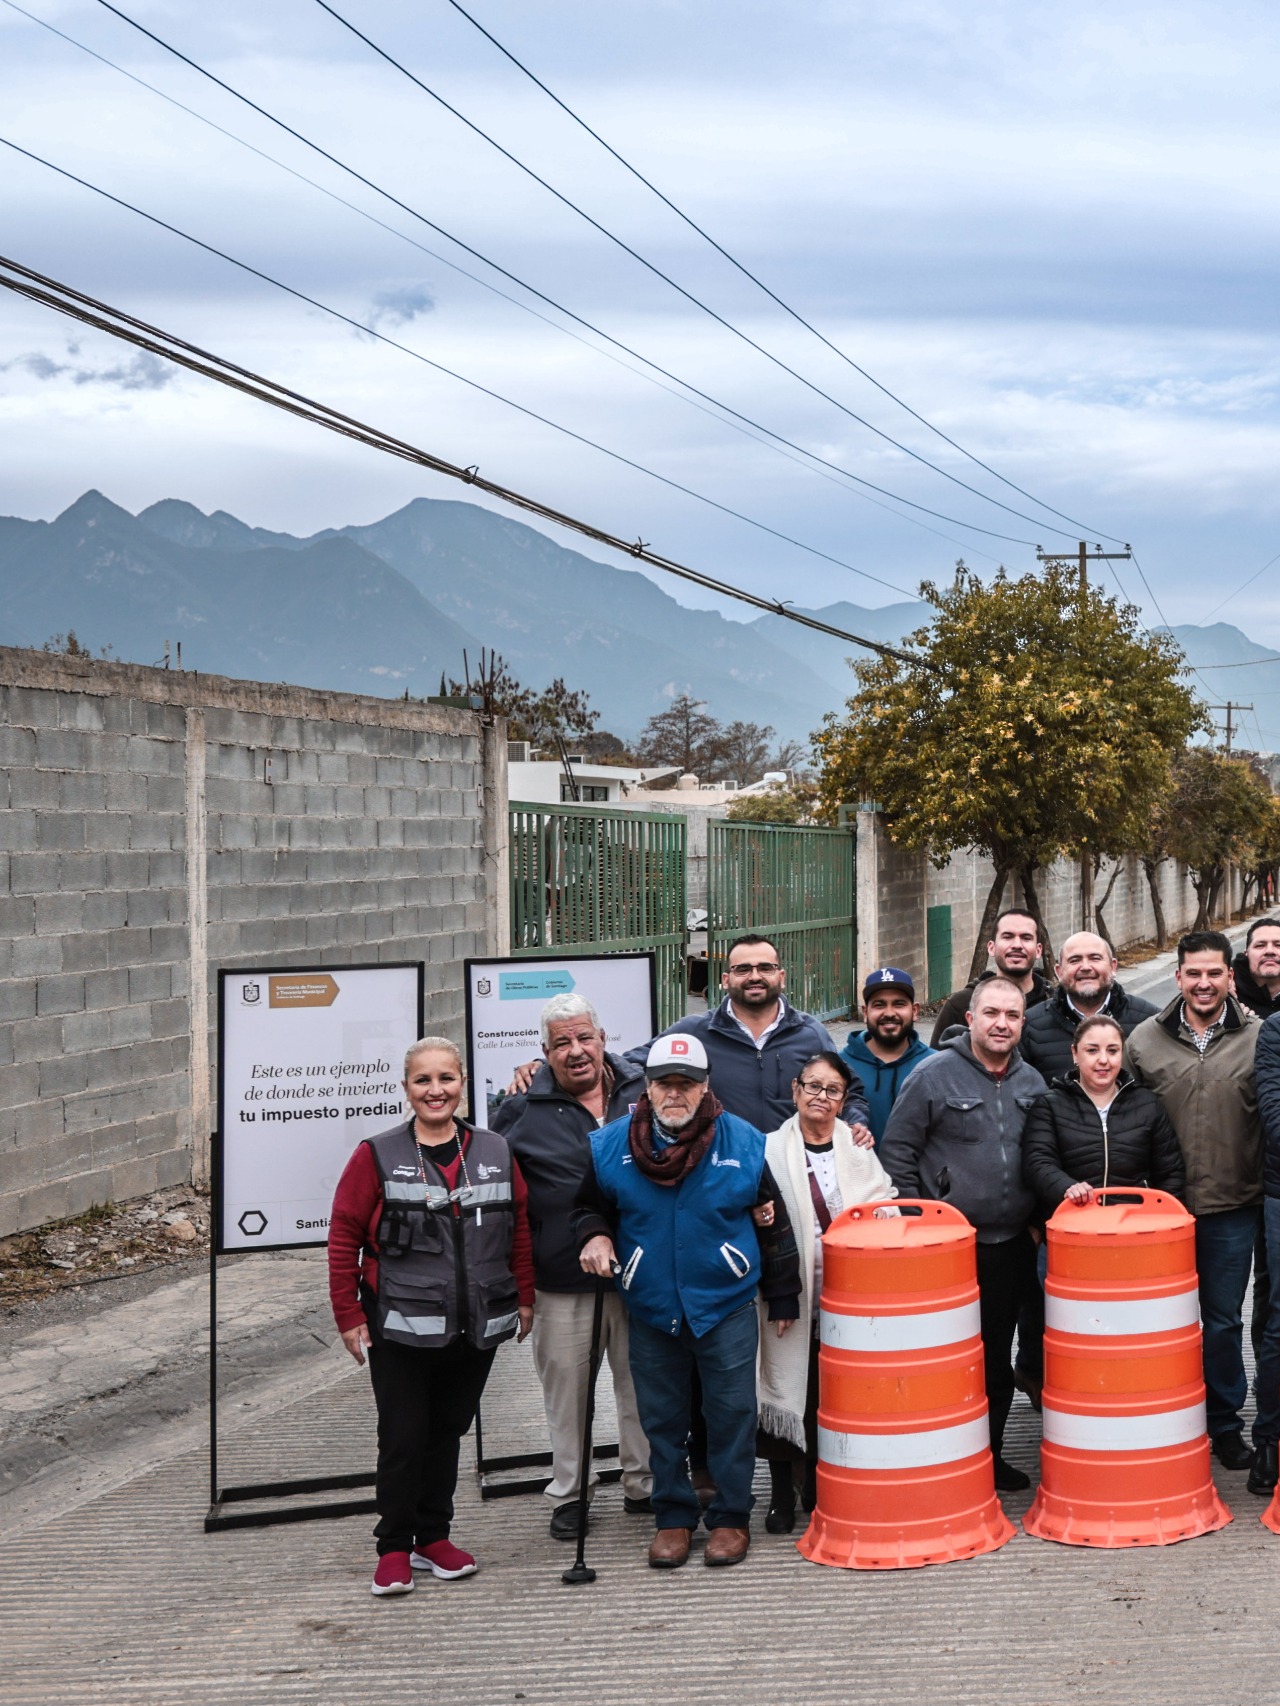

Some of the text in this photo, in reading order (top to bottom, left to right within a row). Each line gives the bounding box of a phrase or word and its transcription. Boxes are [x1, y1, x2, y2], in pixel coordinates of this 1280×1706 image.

[477, 1028, 539, 1039] Construcción
[477, 1040, 498, 1050] Calle
[500, 1040, 514, 1048] Los
[516, 1039, 538, 1048] Silva,
[251, 1058, 390, 1080] Este es un ejemplo
[244, 1081, 397, 1100] de donde se invierte
[239, 1101, 402, 1123] tu impuesto predial
